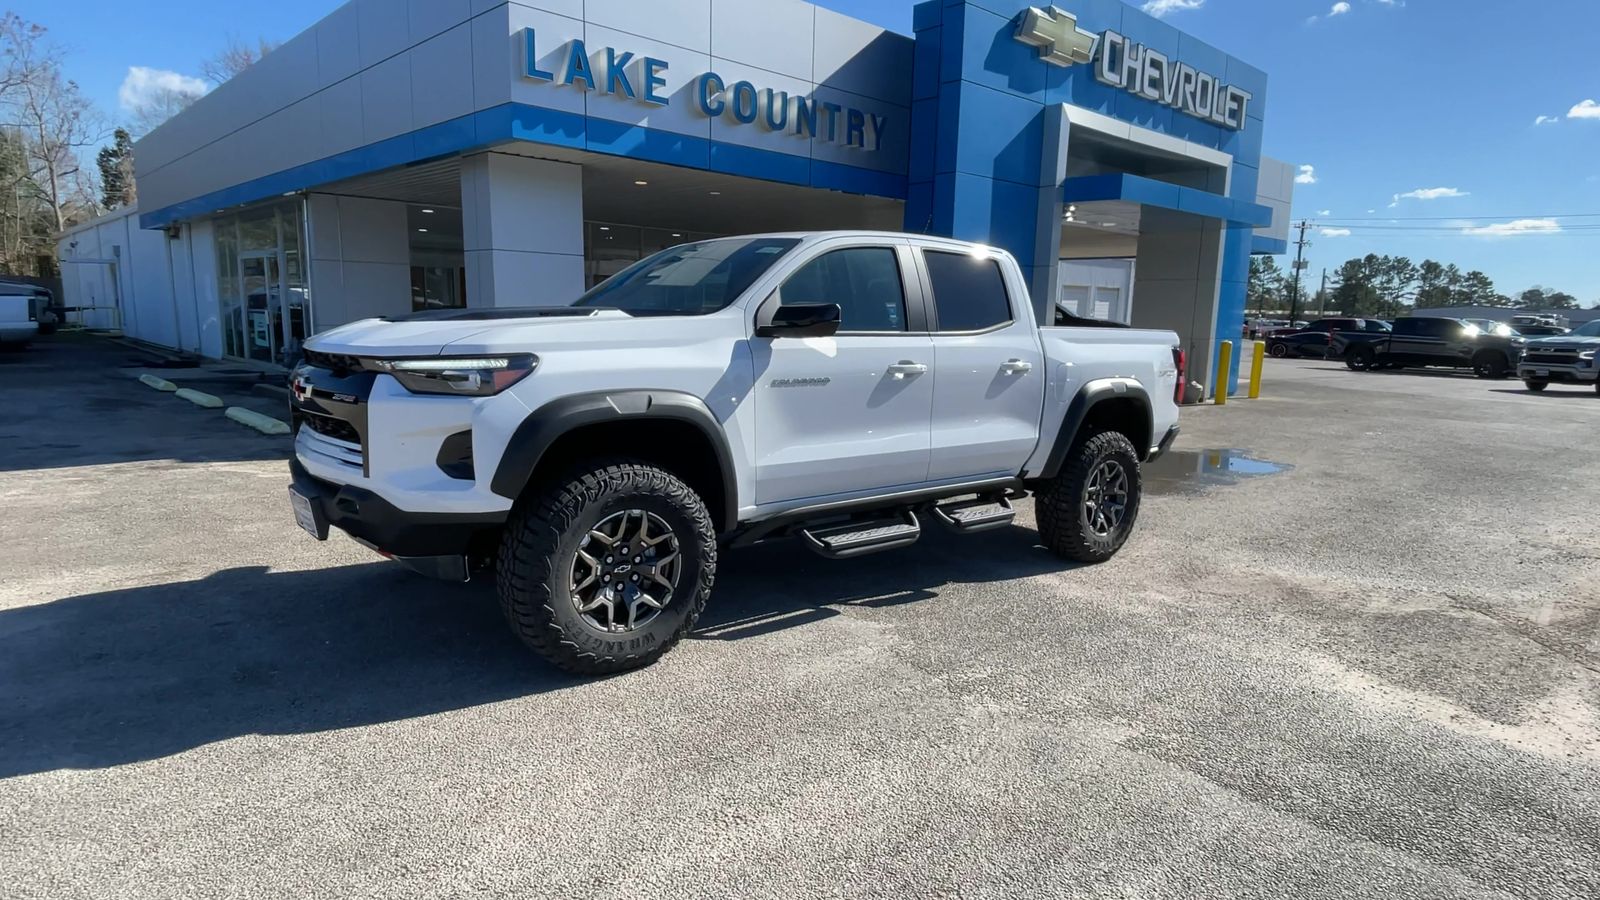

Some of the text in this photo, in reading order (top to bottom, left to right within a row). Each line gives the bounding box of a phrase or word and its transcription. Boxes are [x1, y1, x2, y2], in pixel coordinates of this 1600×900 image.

[522, 26, 889, 151] LAKE COUNTRY
[1098, 29, 1252, 131] CHEVROLET
